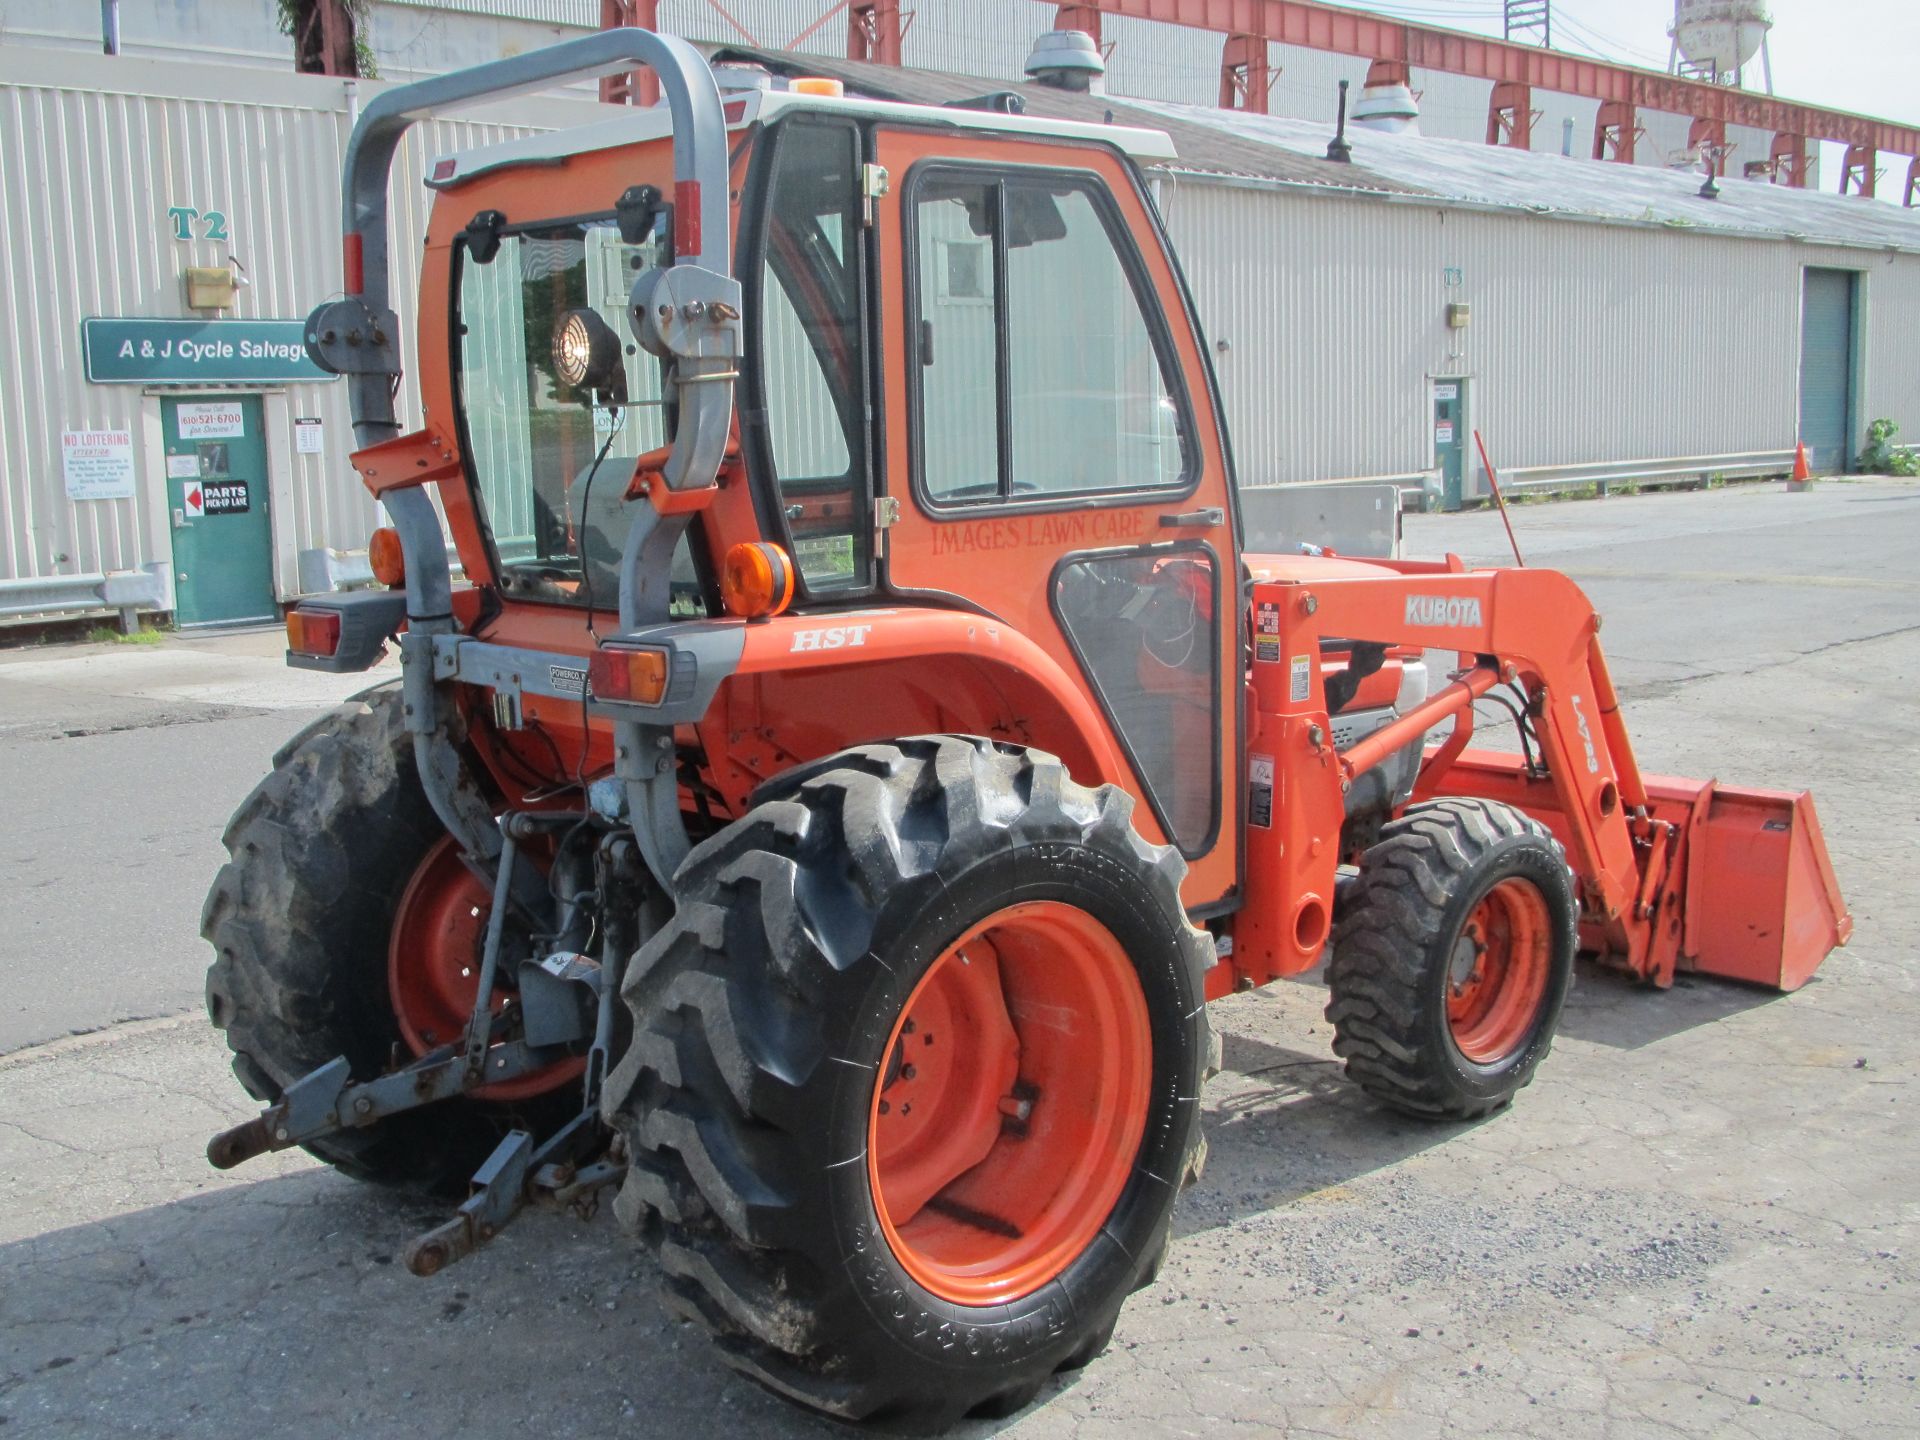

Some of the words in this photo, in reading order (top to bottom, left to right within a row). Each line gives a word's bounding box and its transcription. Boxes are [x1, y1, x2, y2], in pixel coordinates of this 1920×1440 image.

[167, 207, 229, 241] T2
[119, 340, 134, 358] A
[141, 340, 155, 358] &
[161, 340, 172, 358] J
[178, 340, 233, 362] Cycle
[64, 434, 77, 446] NO
[82, 433, 129, 446] LOITERING
[204, 487, 247, 498] PARTS
[206, 498, 230, 507] PICK-UP
[231, 497, 247, 506] LANE
[931, 520, 1020, 555] IMAGES
[1026, 514, 1088, 546] LAWN
[1092, 510, 1144, 540] CARE
[1404, 594, 1483, 627] KUBOTA
[790, 625, 872, 653] HST
